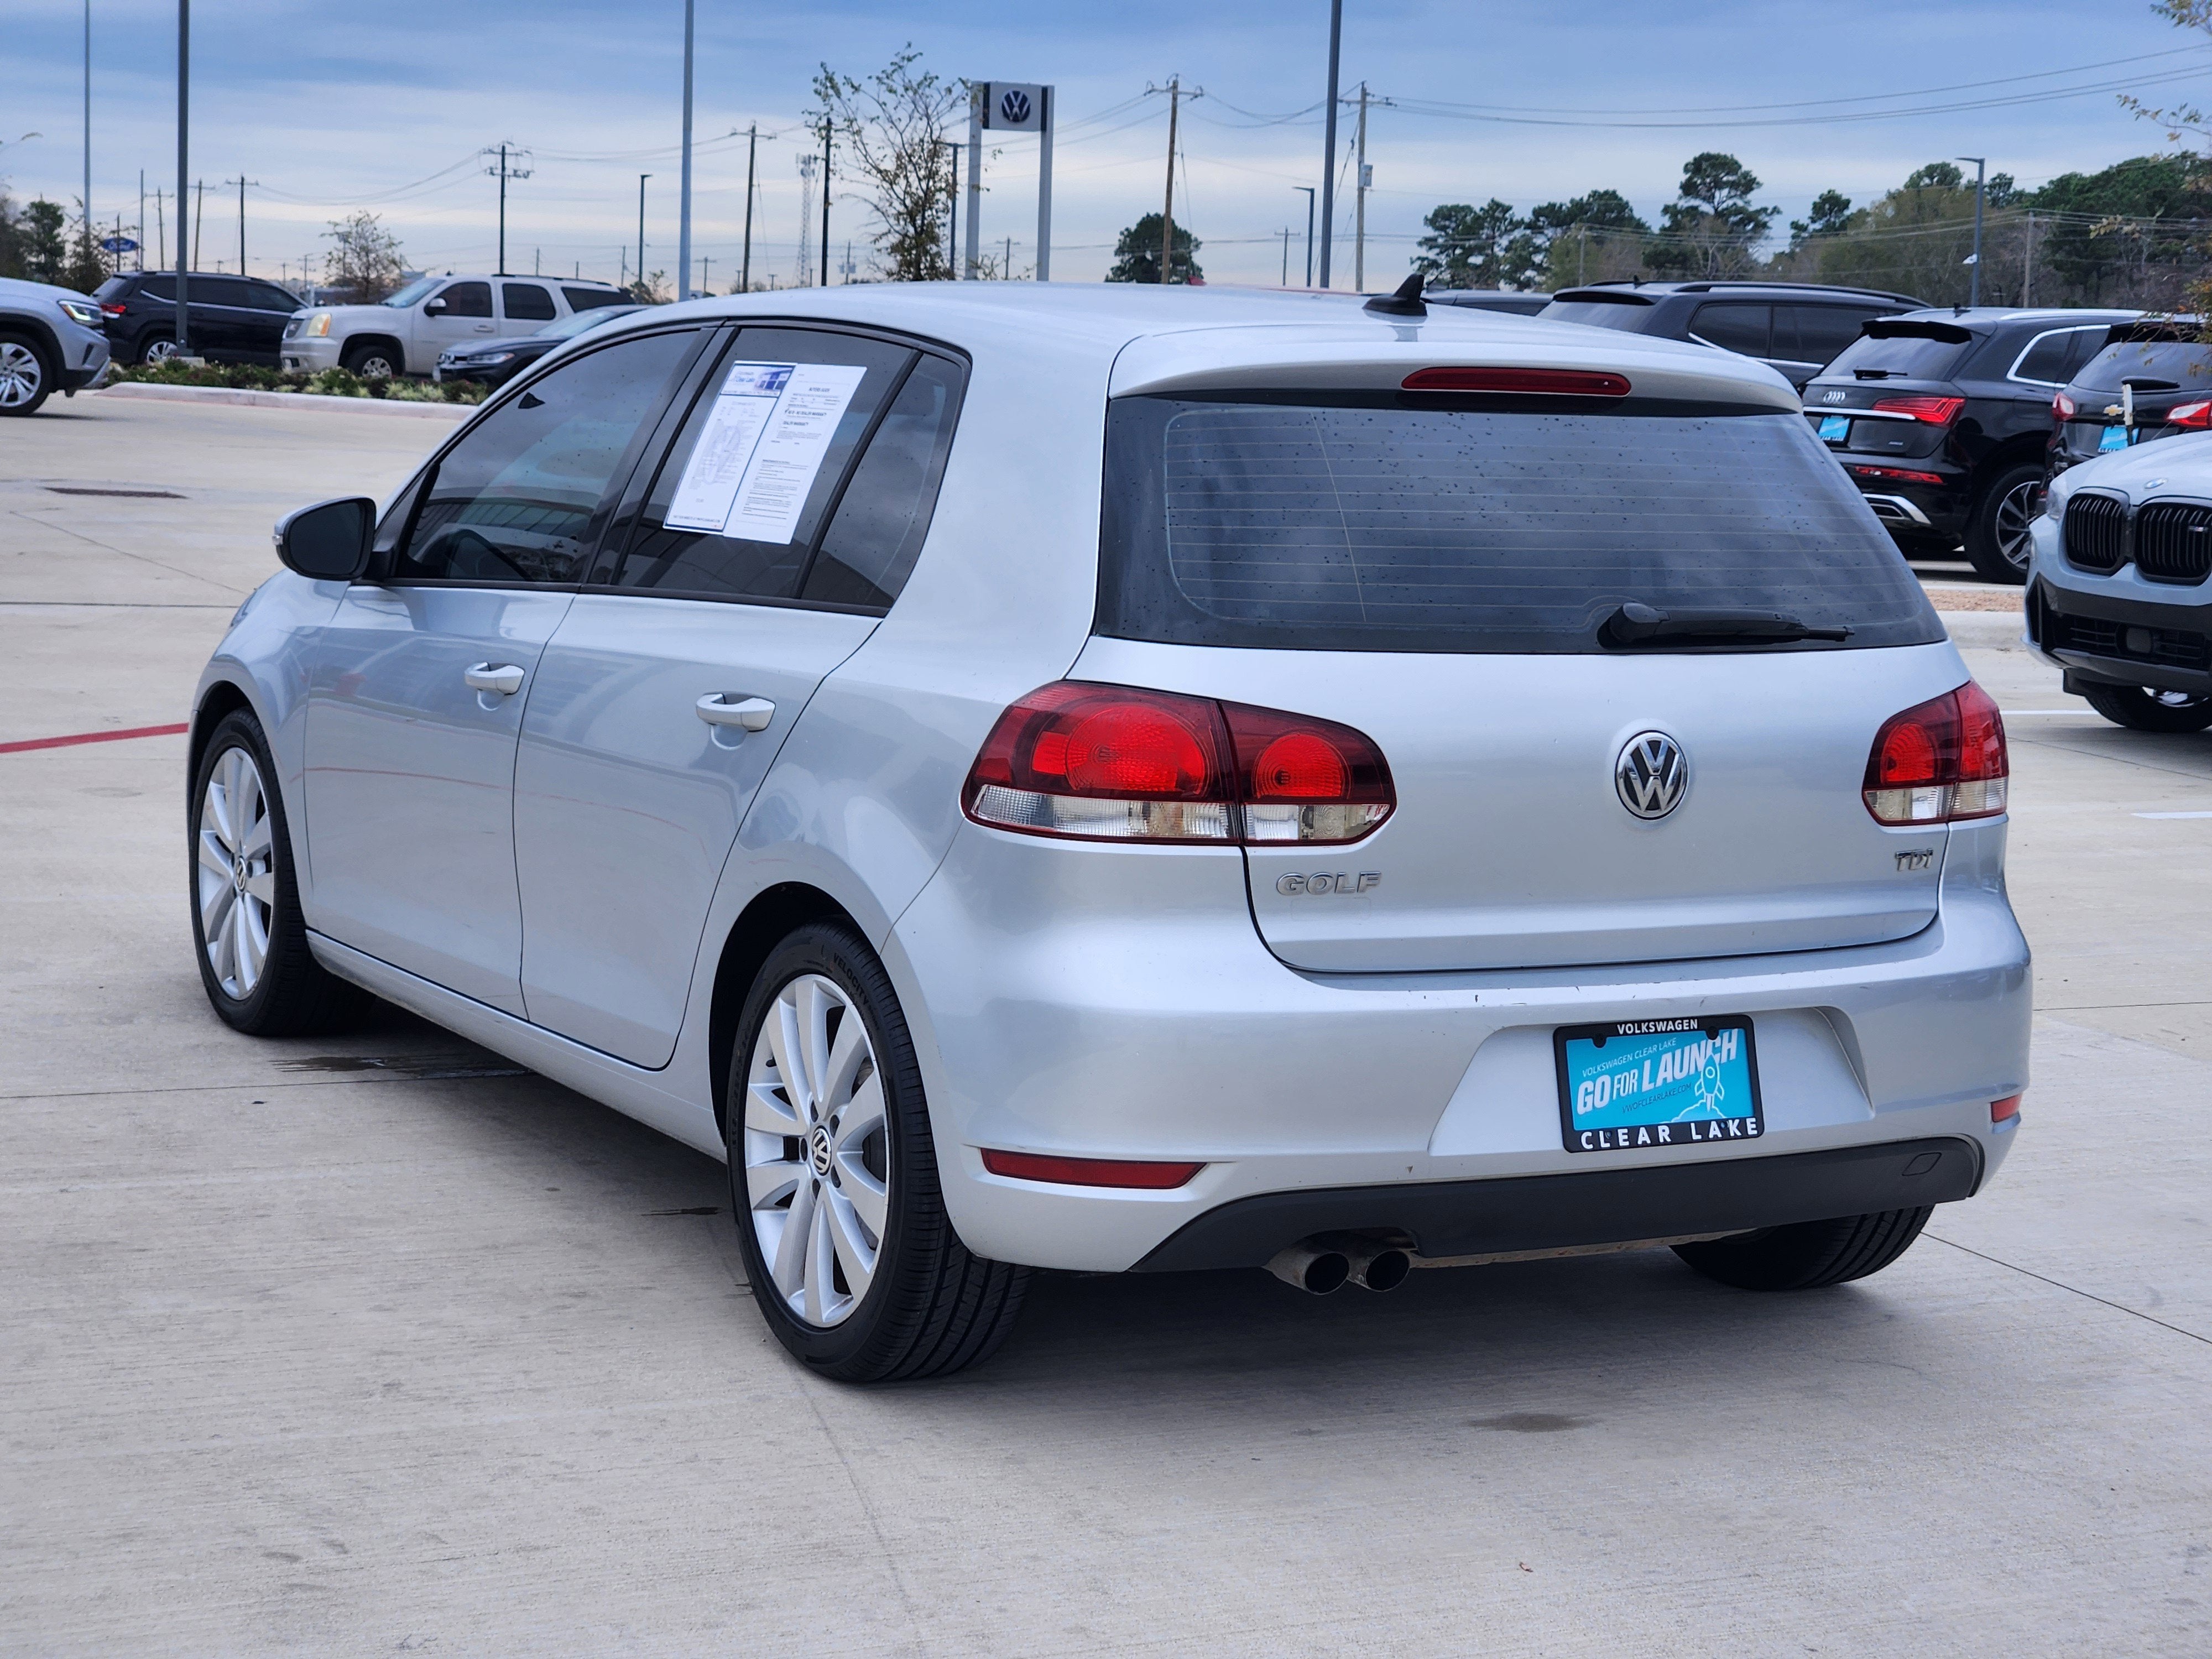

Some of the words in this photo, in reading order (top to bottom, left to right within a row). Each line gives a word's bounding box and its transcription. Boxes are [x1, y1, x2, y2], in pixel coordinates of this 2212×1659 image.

[1615, 730, 1687, 820] VW
[1276, 870, 1382, 896] GOLF
[833, 952, 869, 1005] VELOCITY
[1617, 1019, 1698, 1035] VOLKSWAGEN
[1577, 1074, 1611, 1115] GO
[1613, 1068, 1638, 1100] FOR
[1641, 1029, 1739, 1093] LAUNCH
[1583, 1053, 1633, 1077] VOLKSWAGEN
[1634, 1044, 1657, 1059] CLEAR
[1658, 1037, 1677, 1051] LAKE
[1622, 1083, 1692, 1113] VWOFCLEARLAKE.COM
[1580, 1125, 1672, 1150] CLEAR
[1690, 1117, 1759, 1141] LAKE
